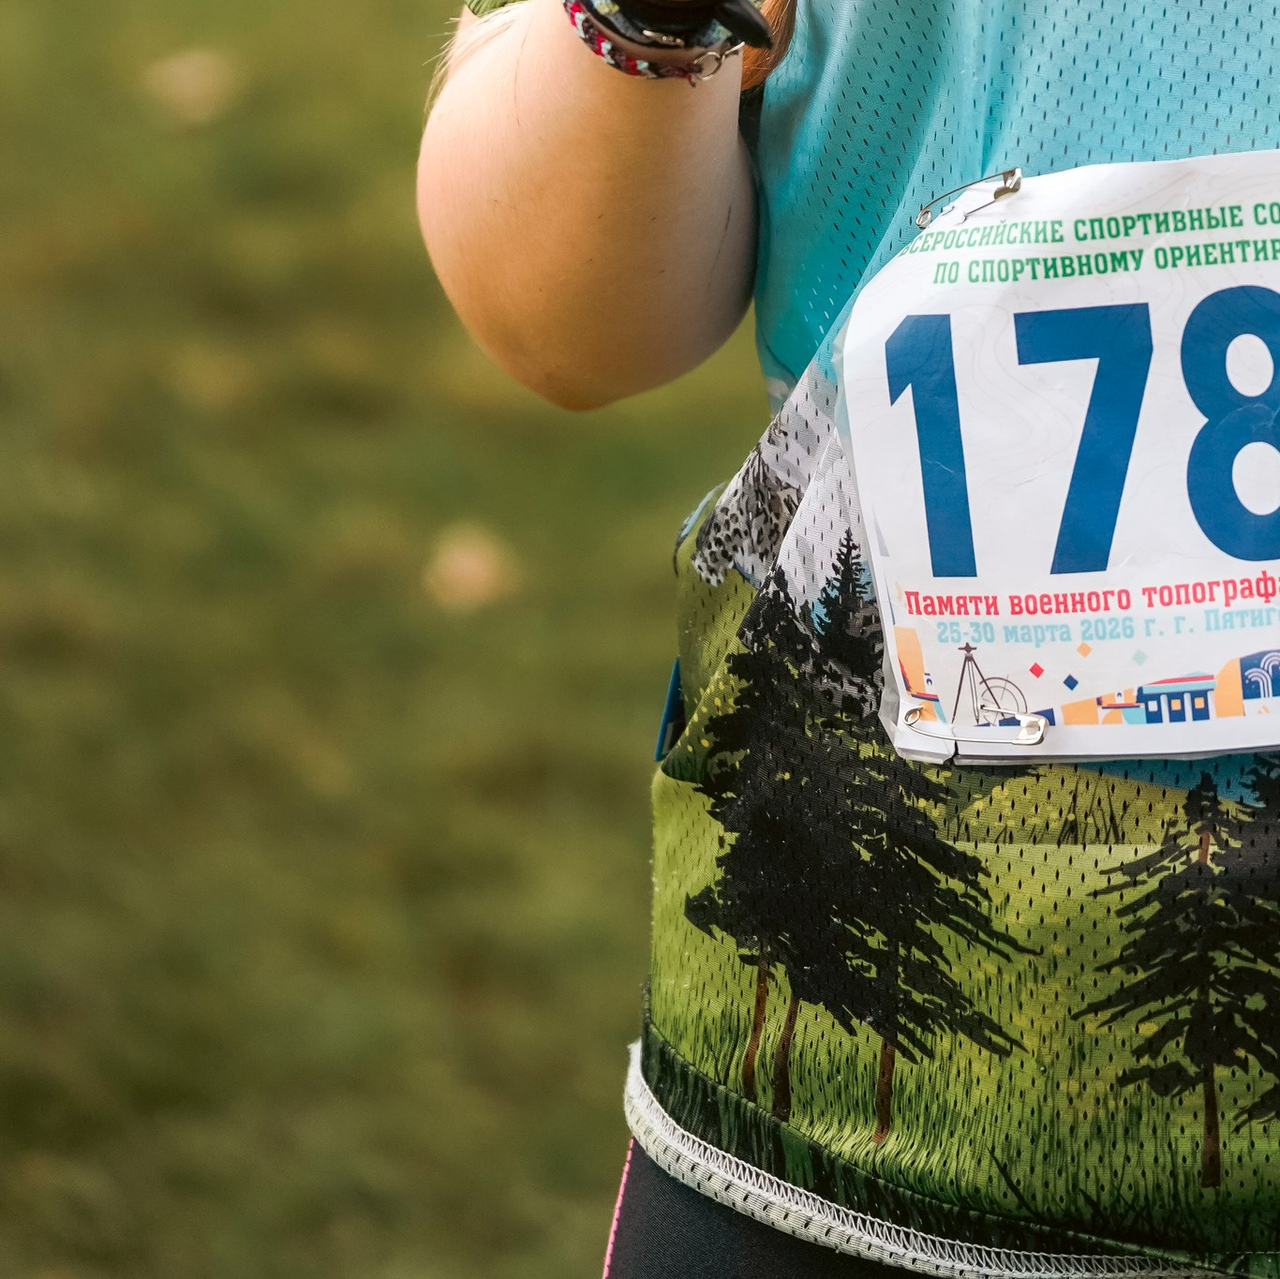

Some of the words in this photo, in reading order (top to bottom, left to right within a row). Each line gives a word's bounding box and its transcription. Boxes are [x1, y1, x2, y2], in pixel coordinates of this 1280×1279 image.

[1073, 204, 1244, 241] СПОРТИВНЫЕ
[933, 259, 959, 284] ПО
[968, 249, 1144, 283] СПОРТИВНОМУ
[905, 590, 1000, 616] Памяти
[1009, 588, 1131, 616] военного
[936, 621, 996, 644] 25-30
[1003, 621, 1073, 648] марта
[1080, 616, 1135, 641] 2026
[1144, 617, 1165, 638] г.
[1174, 613, 1194, 634] г.
